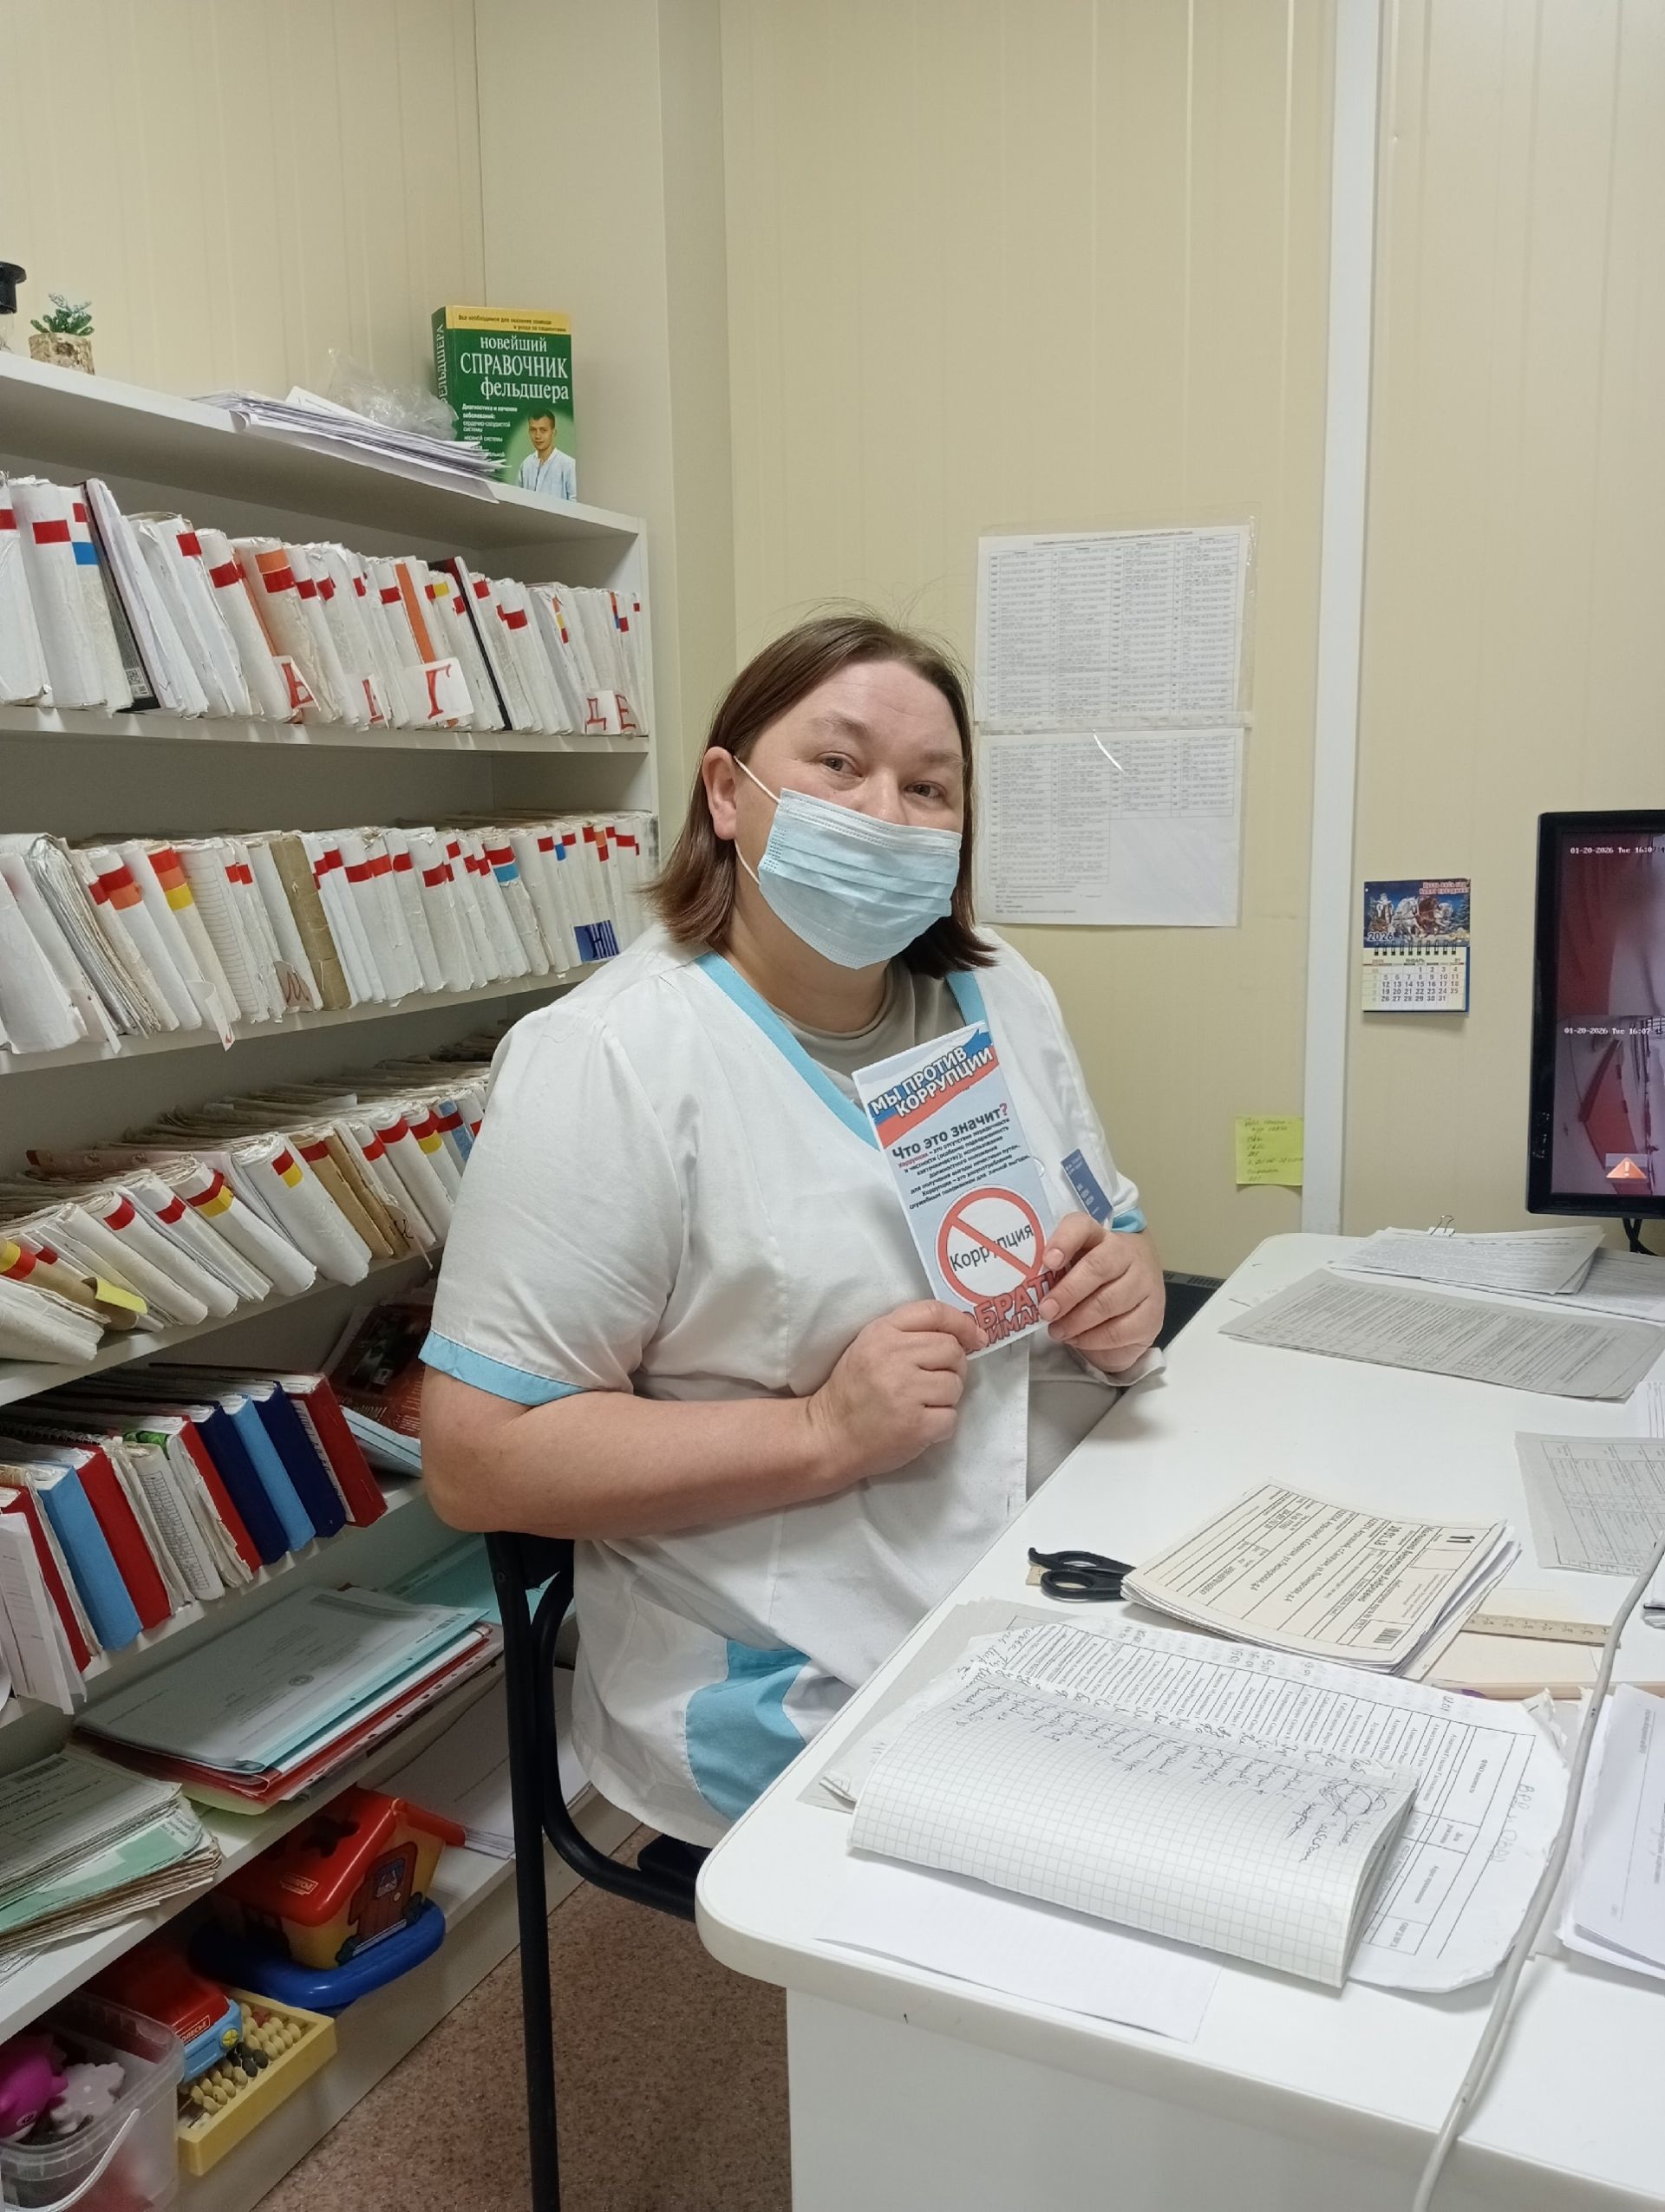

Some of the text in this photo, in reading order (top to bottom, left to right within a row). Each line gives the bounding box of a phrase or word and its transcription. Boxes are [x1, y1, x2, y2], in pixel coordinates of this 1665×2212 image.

[480, 336, 546, 352] новейший
[460, 352, 568, 379] СПРАВОЧНИК
[480, 375, 569, 403] фельдшера
[425, 664, 452, 720] Г
[584, 697, 607, 734] Д
[615, 695, 637, 730] Е
[1368, 932, 1394, 941] 2026
[870, 1046, 967, 1116] МЫ ПРОТИВ
[895, 1047, 994, 1118] КОРРУПЦИИ
[891, 1103, 1009, 1159] Что это значит?
[922, 1180, 952, 1197] Коррупция
